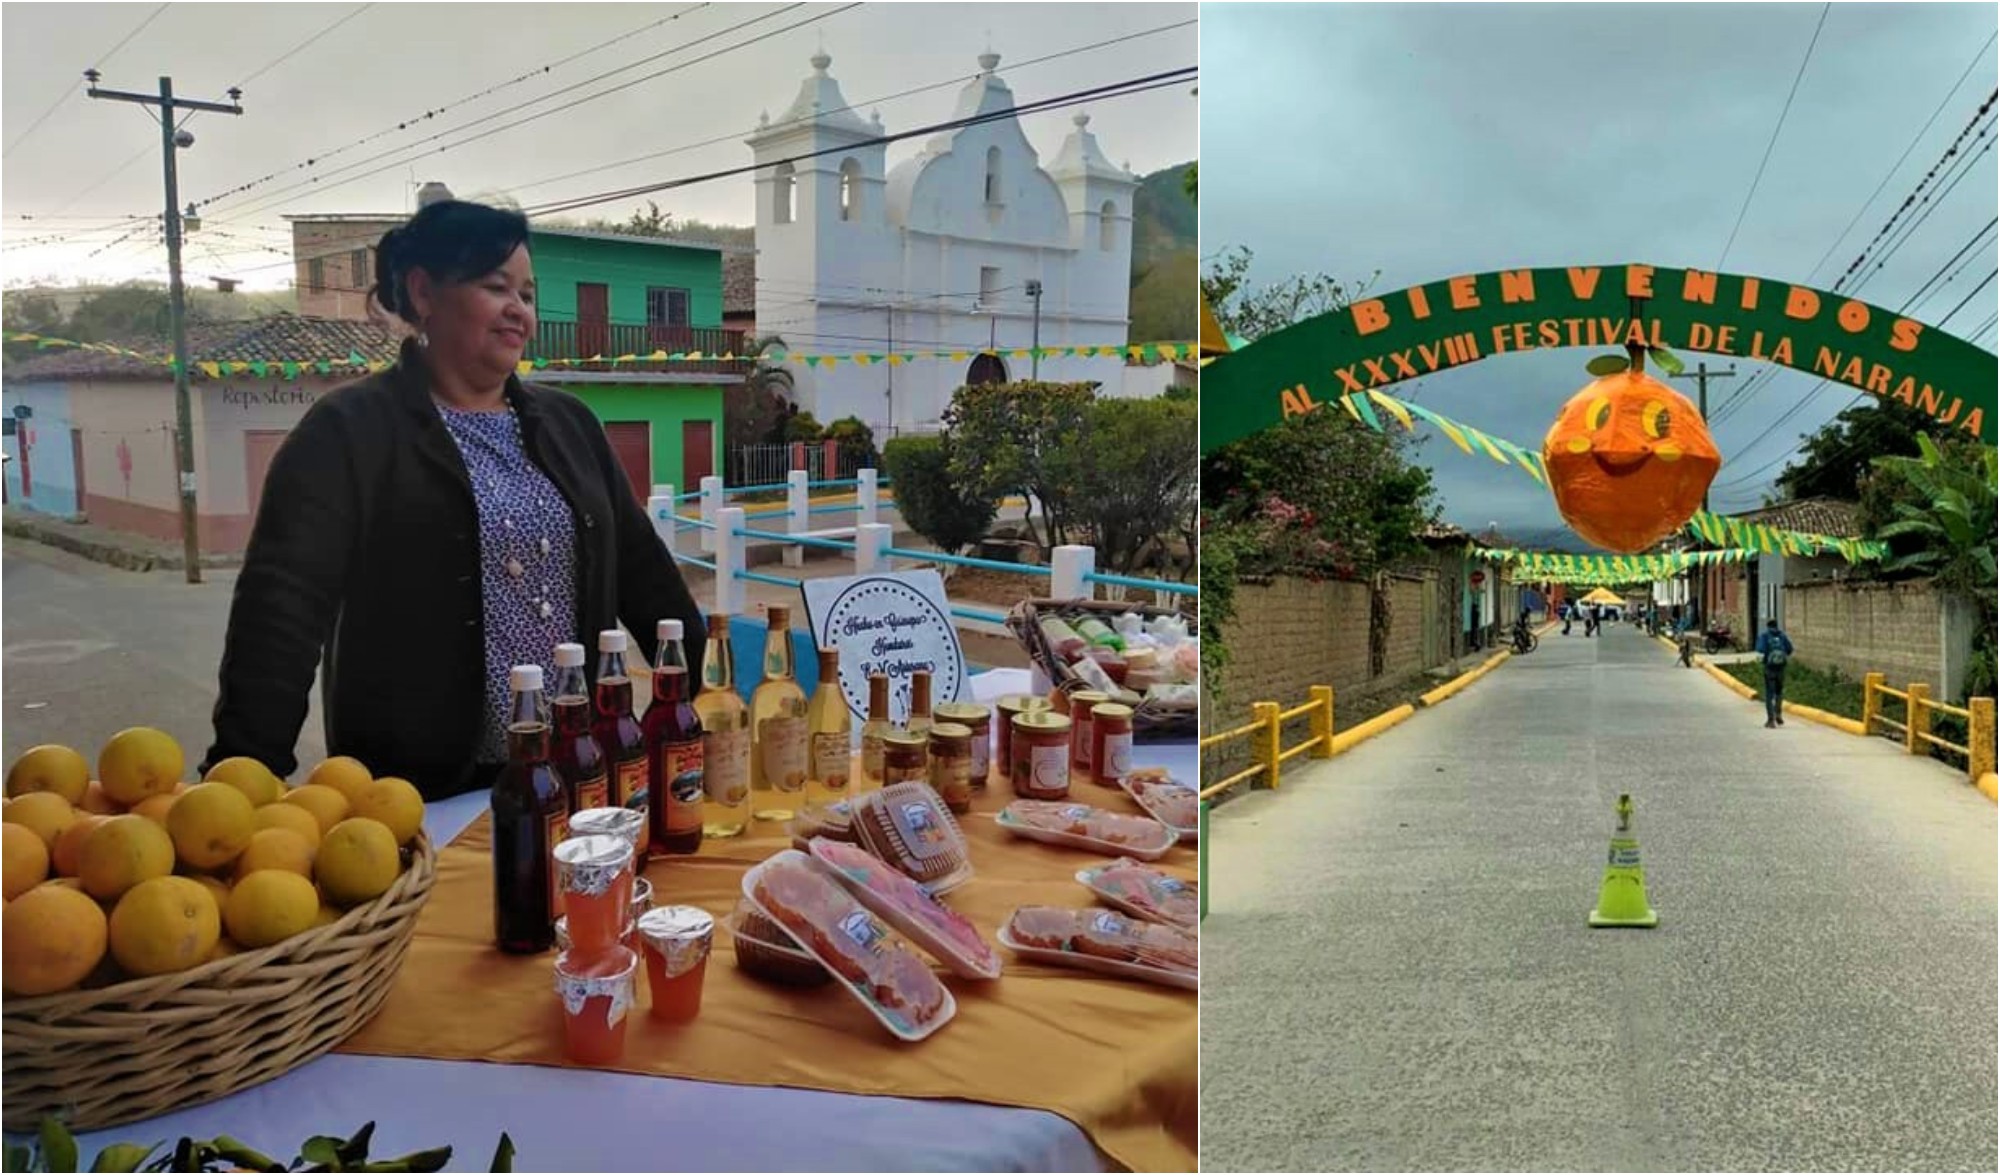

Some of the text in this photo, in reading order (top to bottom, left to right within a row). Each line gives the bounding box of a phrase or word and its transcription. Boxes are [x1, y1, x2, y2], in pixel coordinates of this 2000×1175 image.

[1350, 263, 1924, 352] BIENVENIDOS
[1280, 318, 1984, 437] AL XXXVIII FESTIVAL DE LA NARANJA
